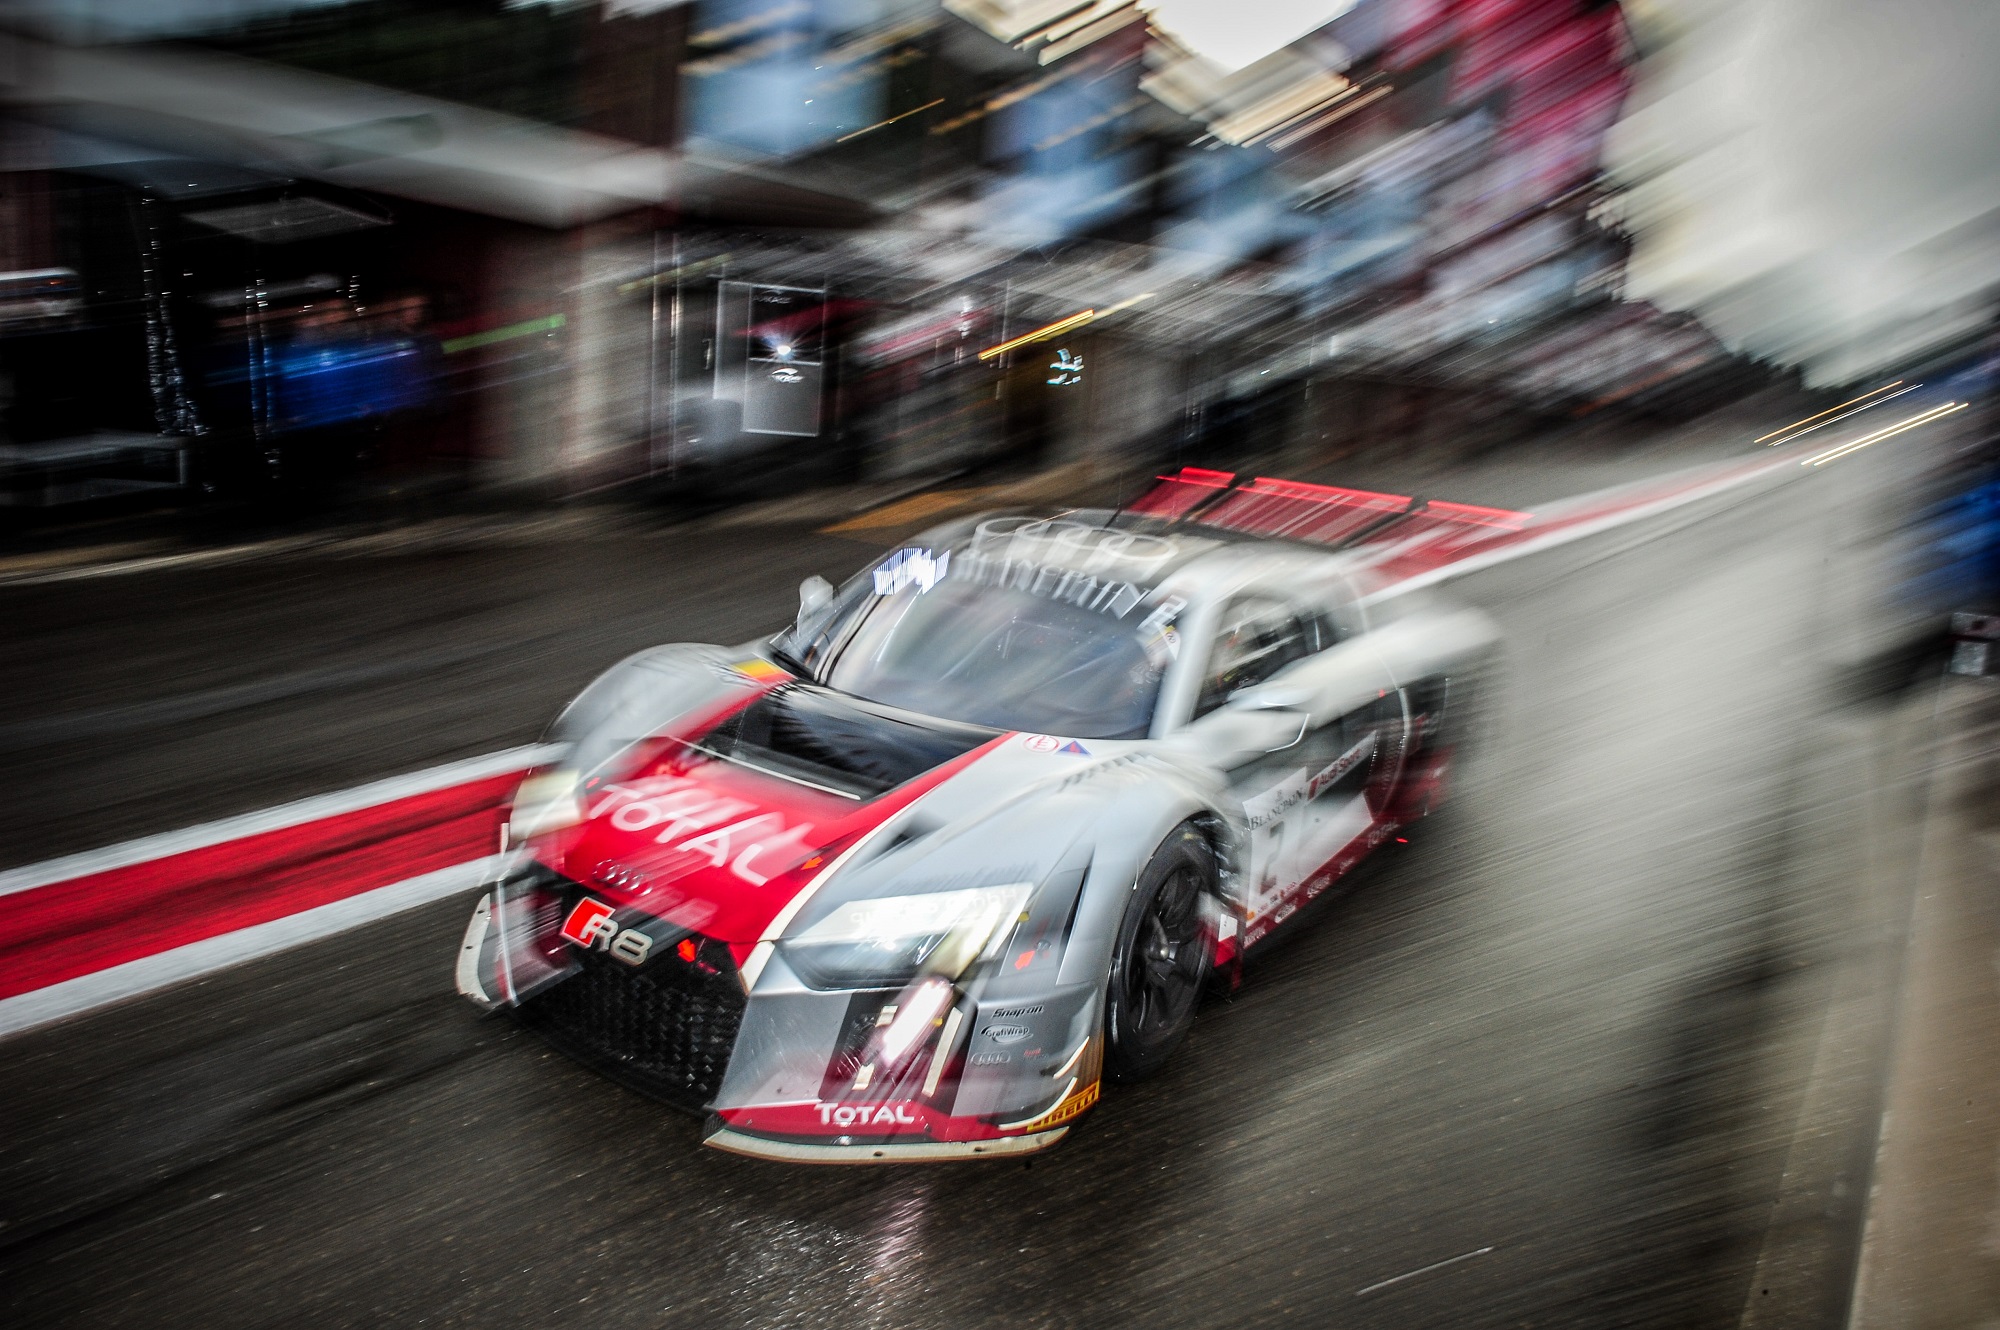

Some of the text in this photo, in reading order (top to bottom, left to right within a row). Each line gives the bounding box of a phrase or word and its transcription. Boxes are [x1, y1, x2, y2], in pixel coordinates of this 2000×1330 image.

[589, 776, 808, 887] TOTAL
[575, 908, 654, 967] R8
[991, 1005, 1044, 1018] Snap-on
[814, 1102, 915, 1125] TOTAL
